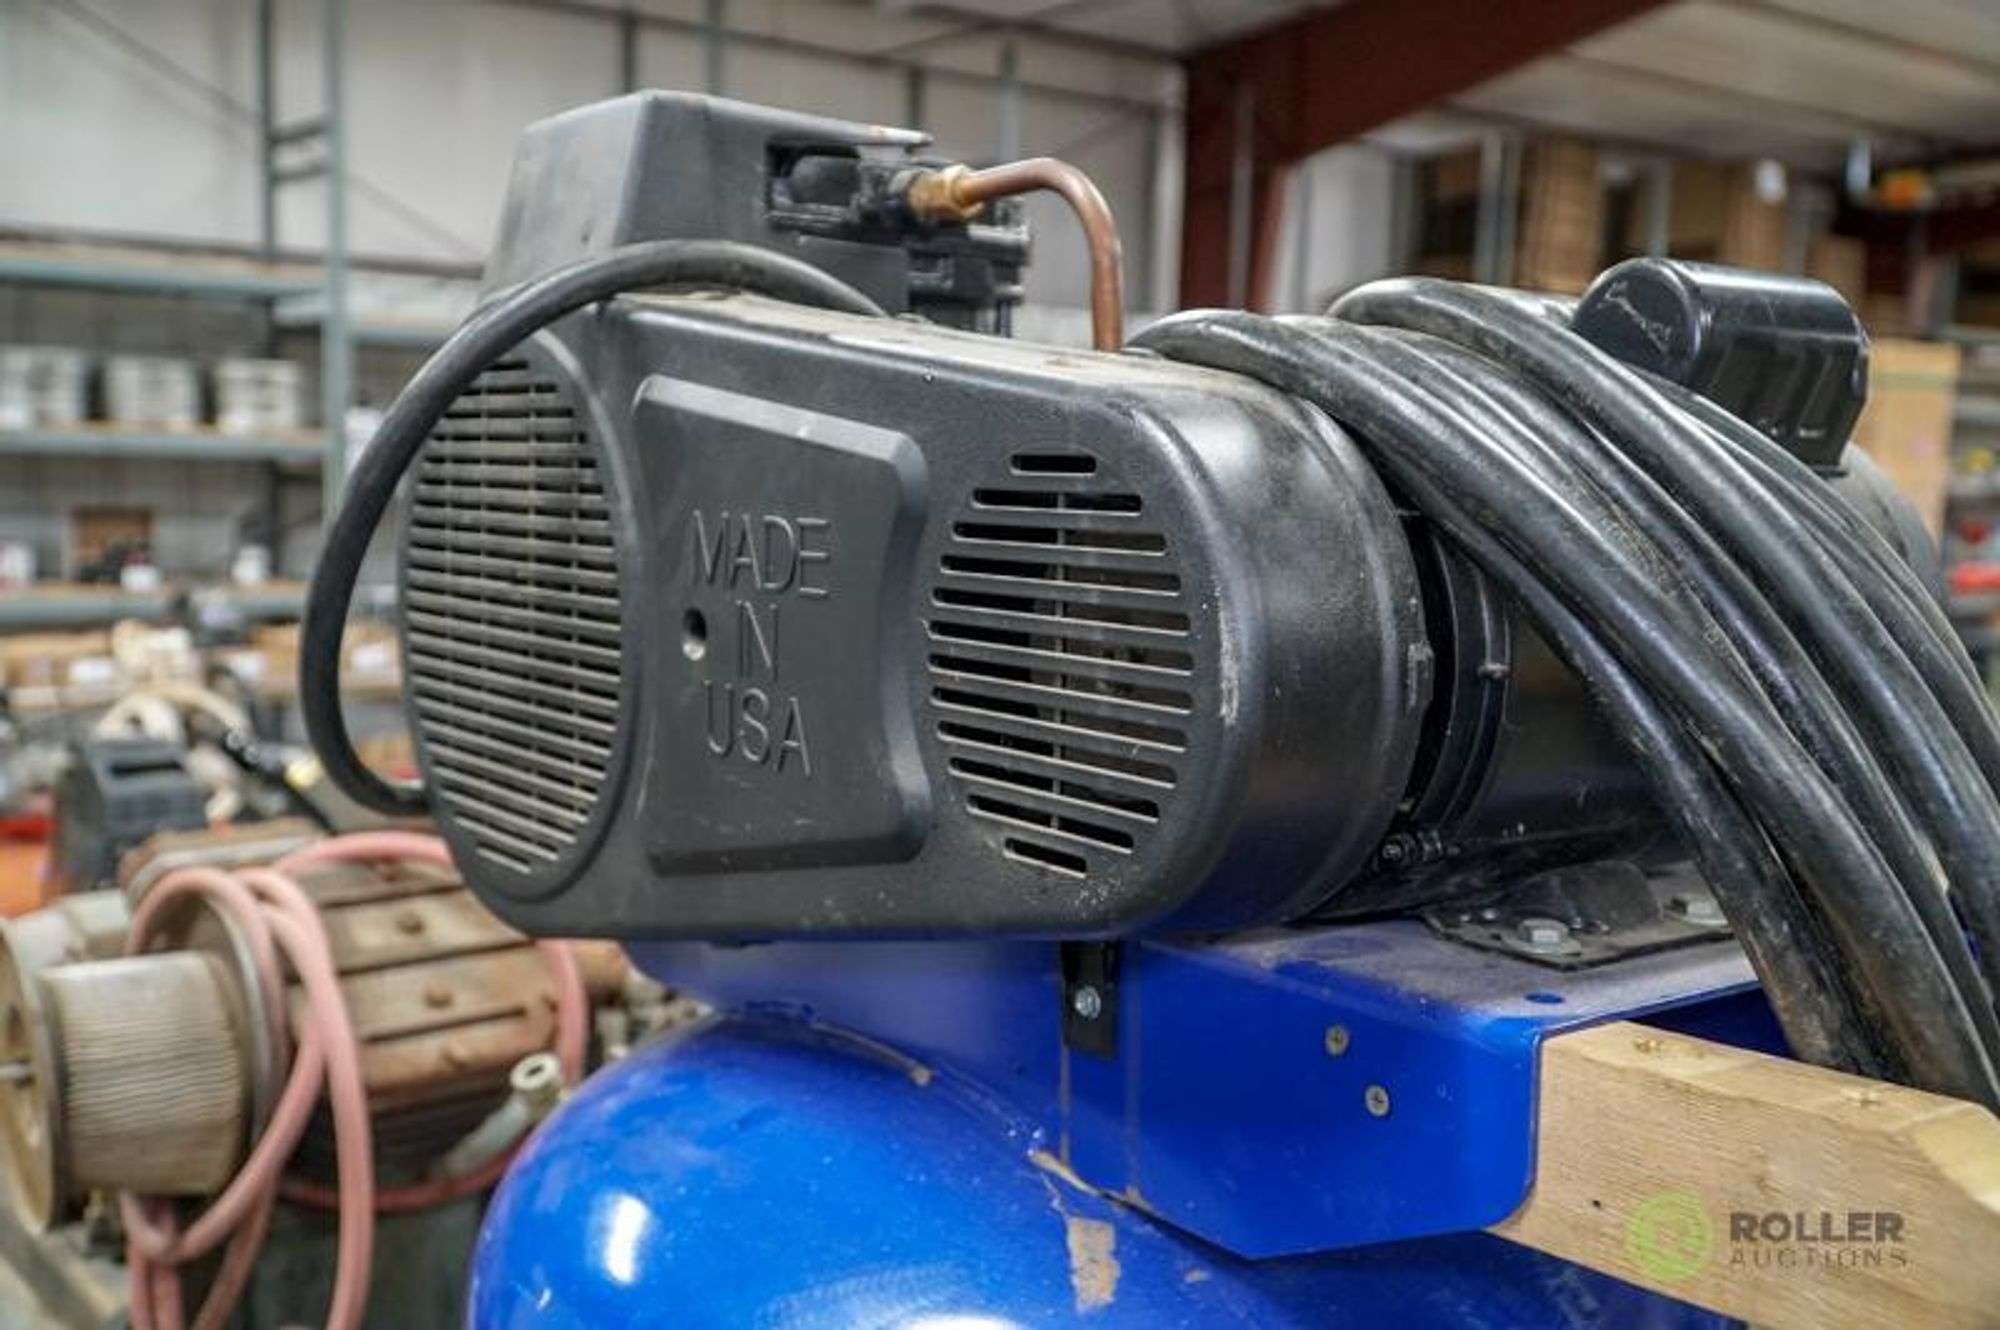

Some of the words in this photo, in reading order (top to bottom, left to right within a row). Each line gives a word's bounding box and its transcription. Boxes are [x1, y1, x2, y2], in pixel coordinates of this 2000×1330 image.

[692, 510, 830, 598] MADE
[735, 600, 779, 681] IN
[703, 679, 812, 775] USA
